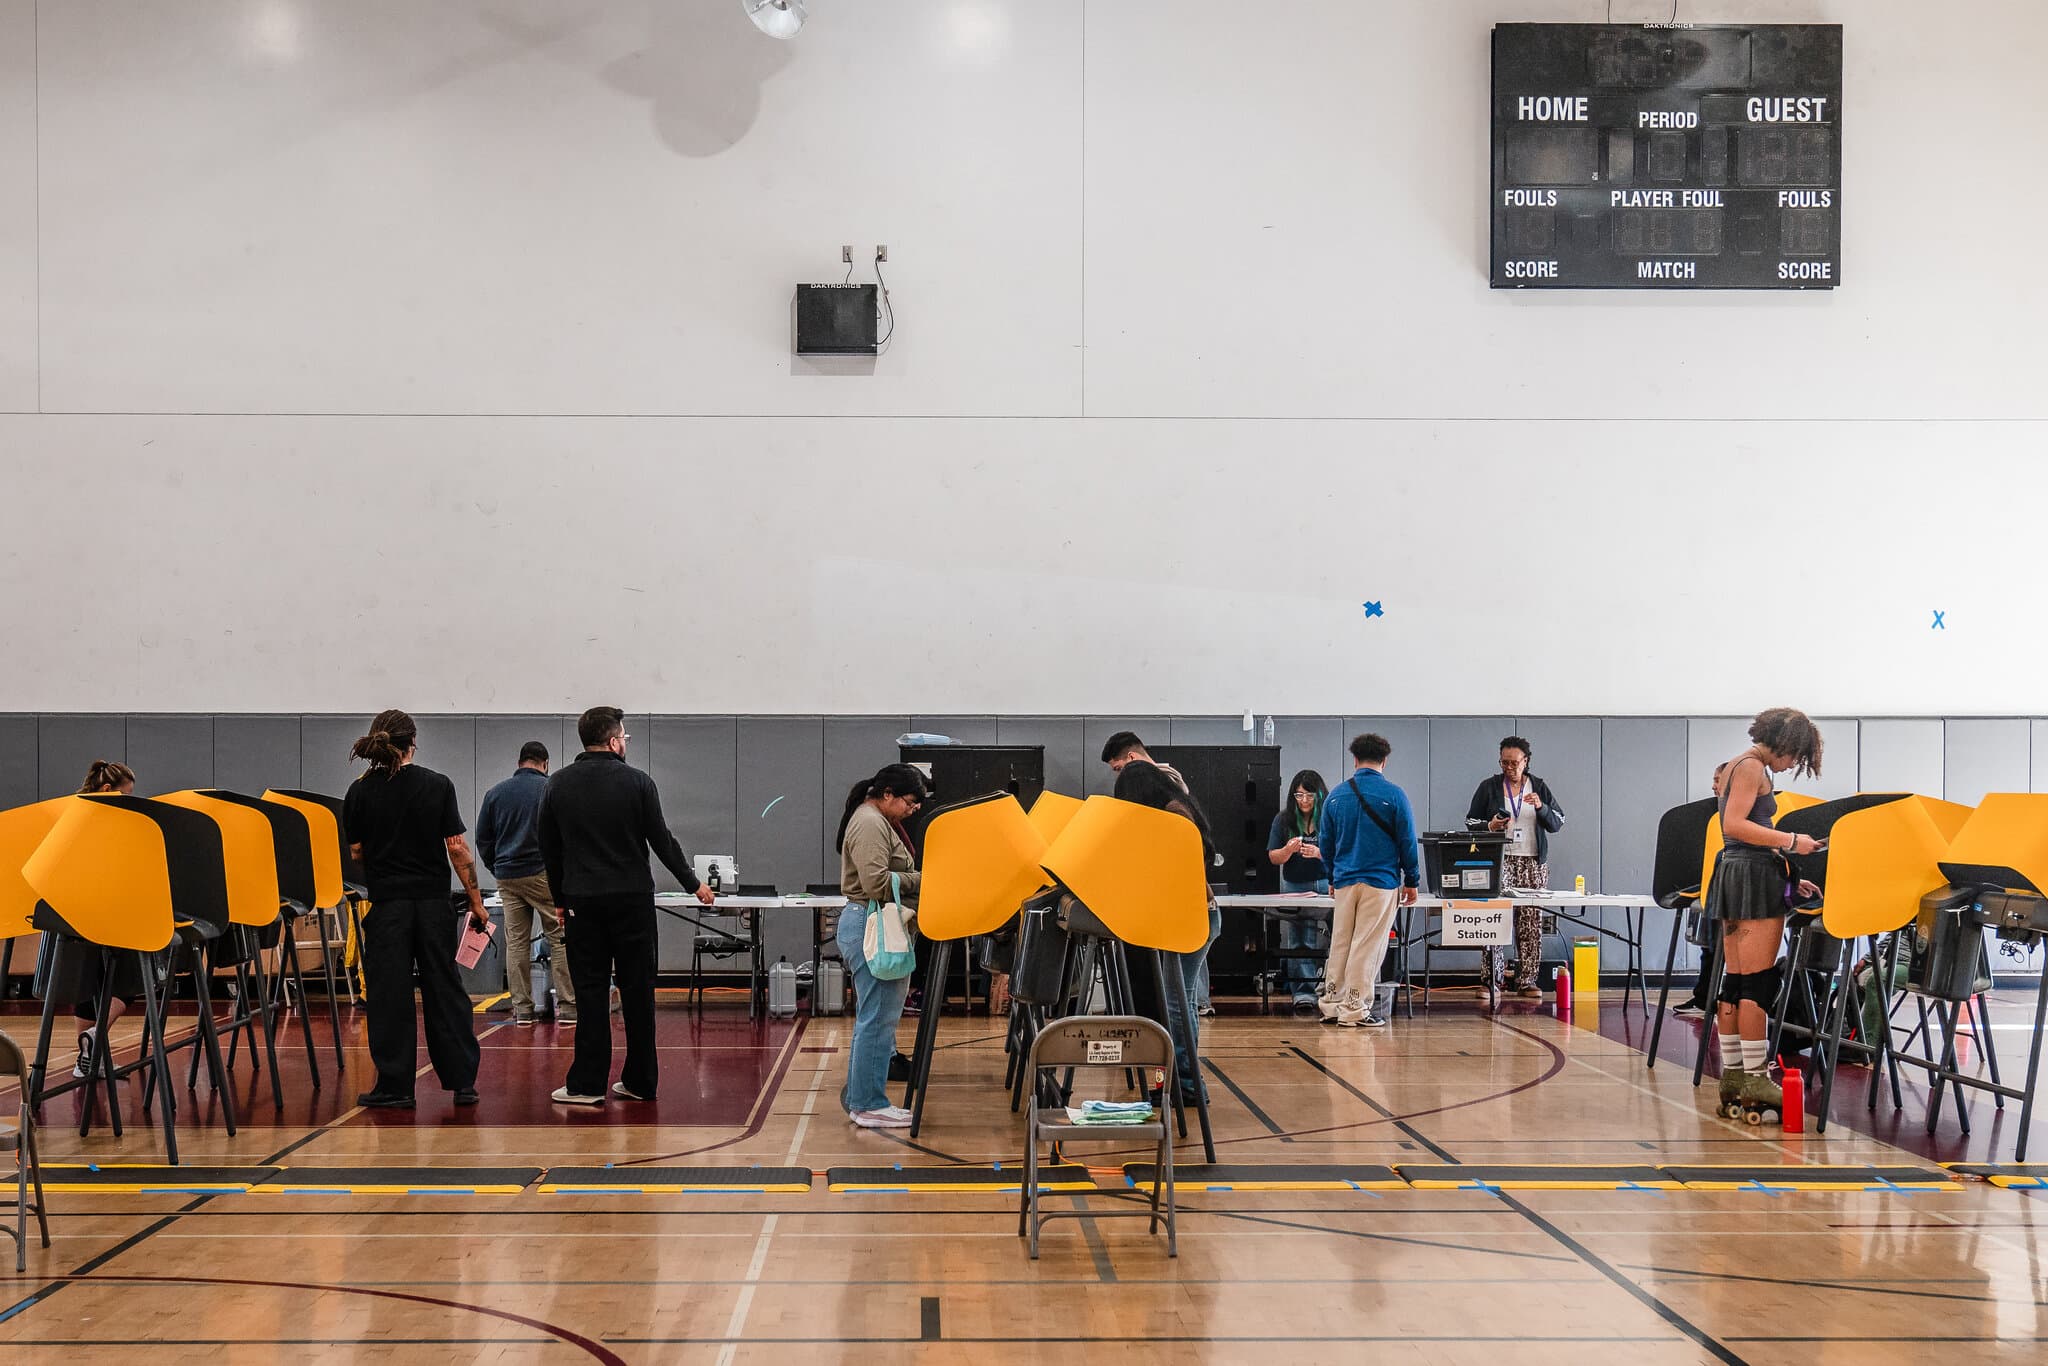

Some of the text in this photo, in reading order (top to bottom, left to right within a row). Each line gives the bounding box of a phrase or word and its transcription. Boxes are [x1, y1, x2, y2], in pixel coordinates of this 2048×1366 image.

[1518, 96, 1588, 121] HOME
[1746, 97, 1827, 122] GUEST
[1639, 111, 1698, 129] PERIOD
[1504, 189, 1558, 207] FOULS
[1611, 191, 1724, 208] PLAYER FOUL
[1778, 191, 1831, 208] FOULS
[1505, 261, 1558, 278] SCORE
[1637, 261, 1695, 279] MATCH
[1778, 262, 1831, 280] SCORE
[1453, 914, 1502, 925] Drop-off
[1457, 930, 1497, 939] Station
